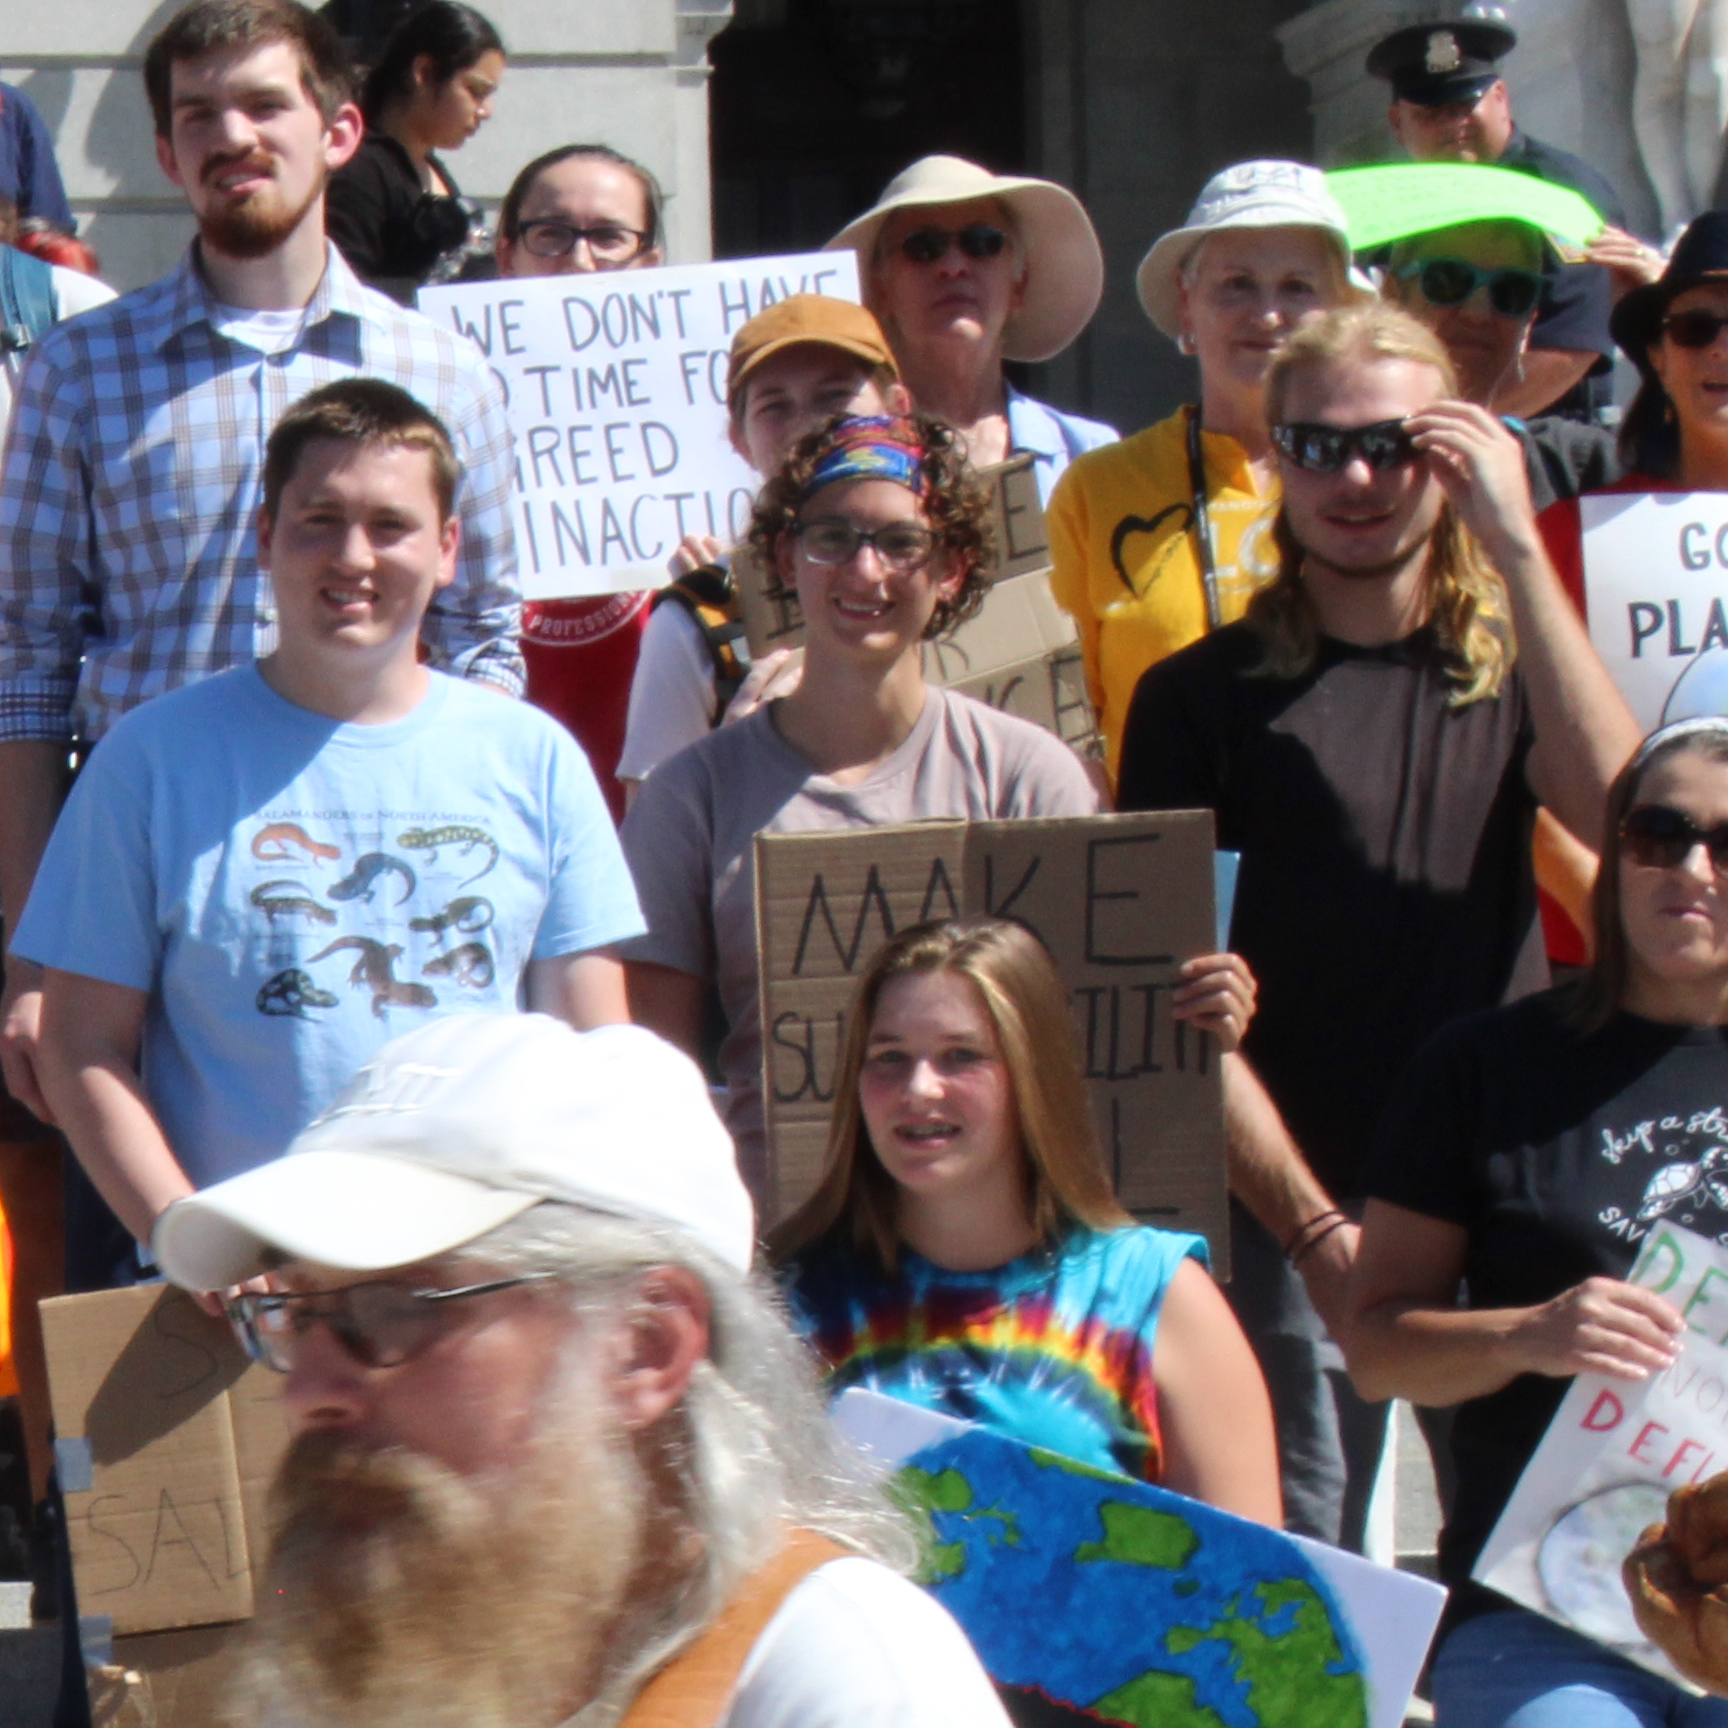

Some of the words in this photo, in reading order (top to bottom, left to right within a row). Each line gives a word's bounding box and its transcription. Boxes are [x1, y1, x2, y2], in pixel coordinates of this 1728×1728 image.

[452, 300, 526, 357] WE
[564, 290, 691, 352] DON'T
[526, 352, 649, 408] TIME
[792, 834, 1175, 975] MAKE
